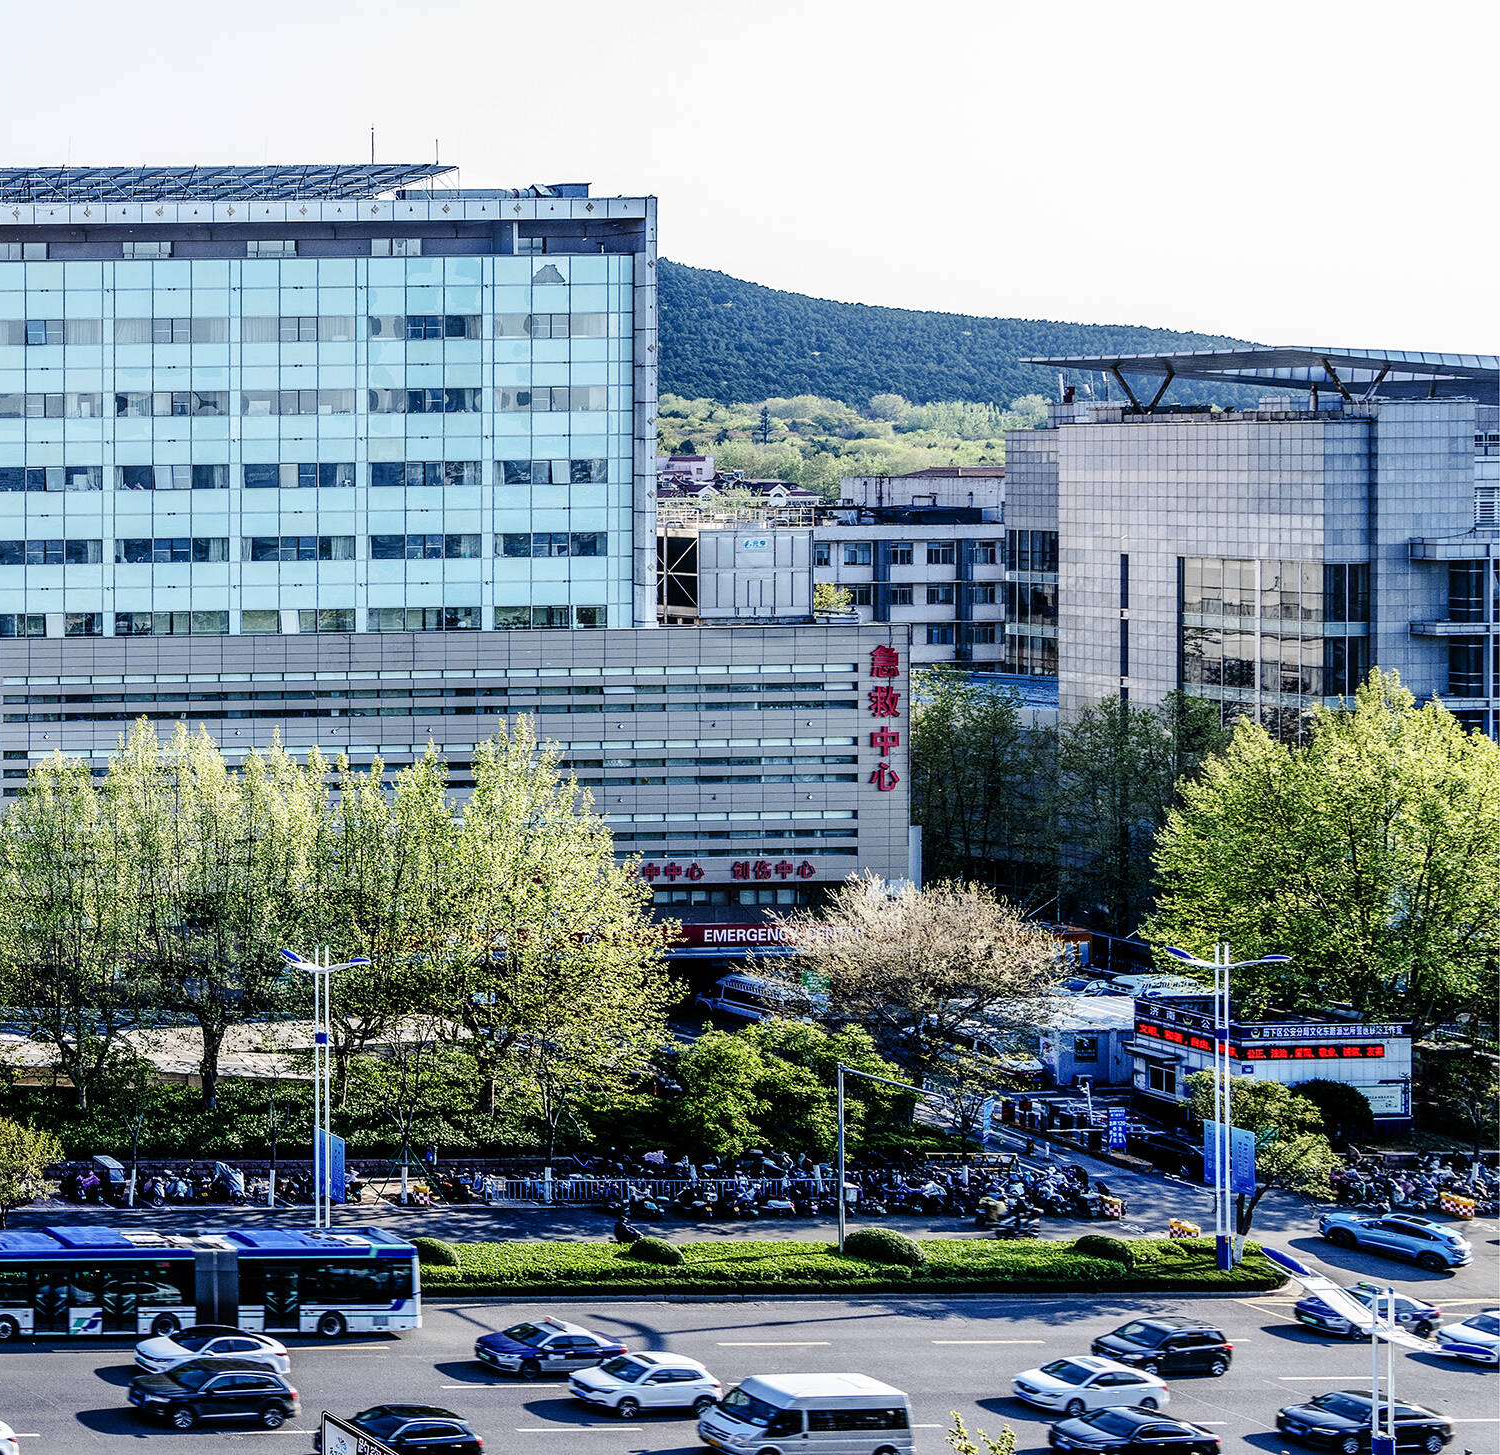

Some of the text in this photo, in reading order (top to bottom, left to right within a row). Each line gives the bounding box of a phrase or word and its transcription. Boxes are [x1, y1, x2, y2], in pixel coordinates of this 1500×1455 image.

[870, 645, 900, 791] 急救中心
[628, 860, 816, 881] 中中心 创伤中心
[1150, 1005, 1176, 1020] 济南
